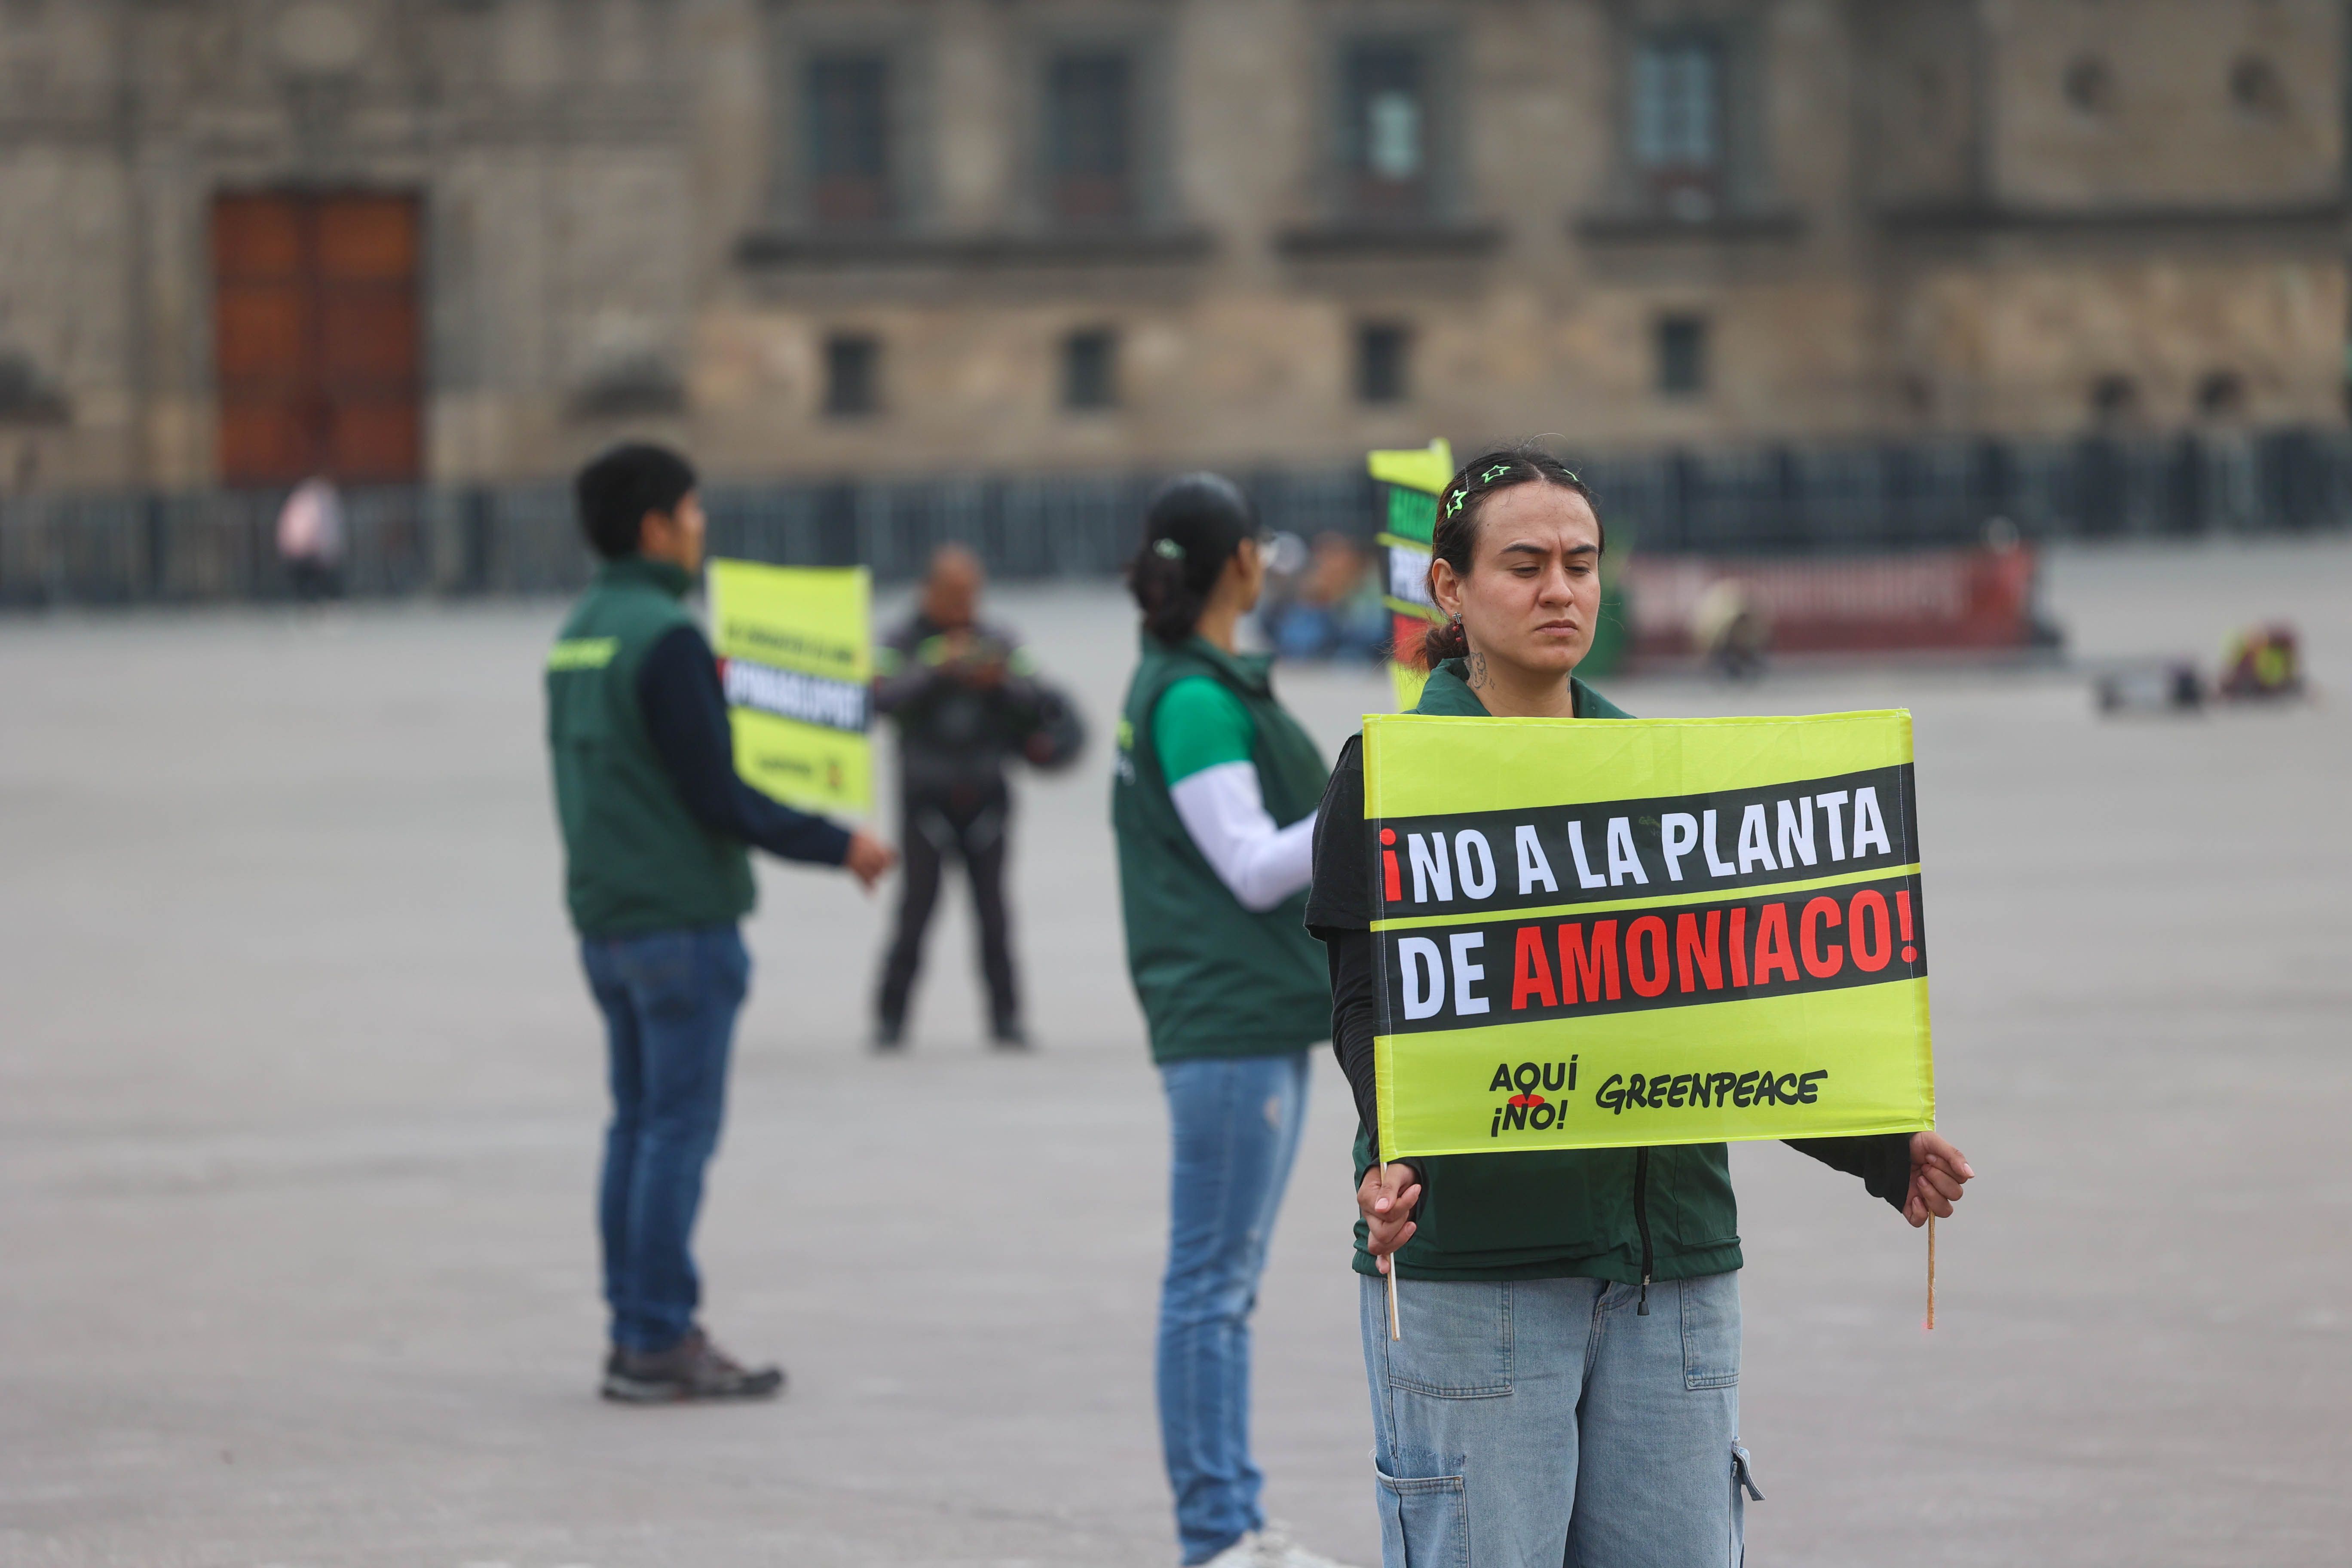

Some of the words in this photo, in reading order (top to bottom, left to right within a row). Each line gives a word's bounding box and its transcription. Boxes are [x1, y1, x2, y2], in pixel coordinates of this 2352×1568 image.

[1379, 827, 1497, 903] ¡NO
[1515, 824, 1559, 895] A
[1568, 817, 1649, 889] LA
[1661, 786, 1891, 881] PLANTA
[1398, 931, 1490, 1020] DE
[1511, 889, 1918, 1010] AMONIACO!
[1489, 1054, 1578, 1101] AQUÍ
[1596, 1069, 1828, 1115] GREENPEACE
[1491, 1099, 1568, 1137] ¡NO!
